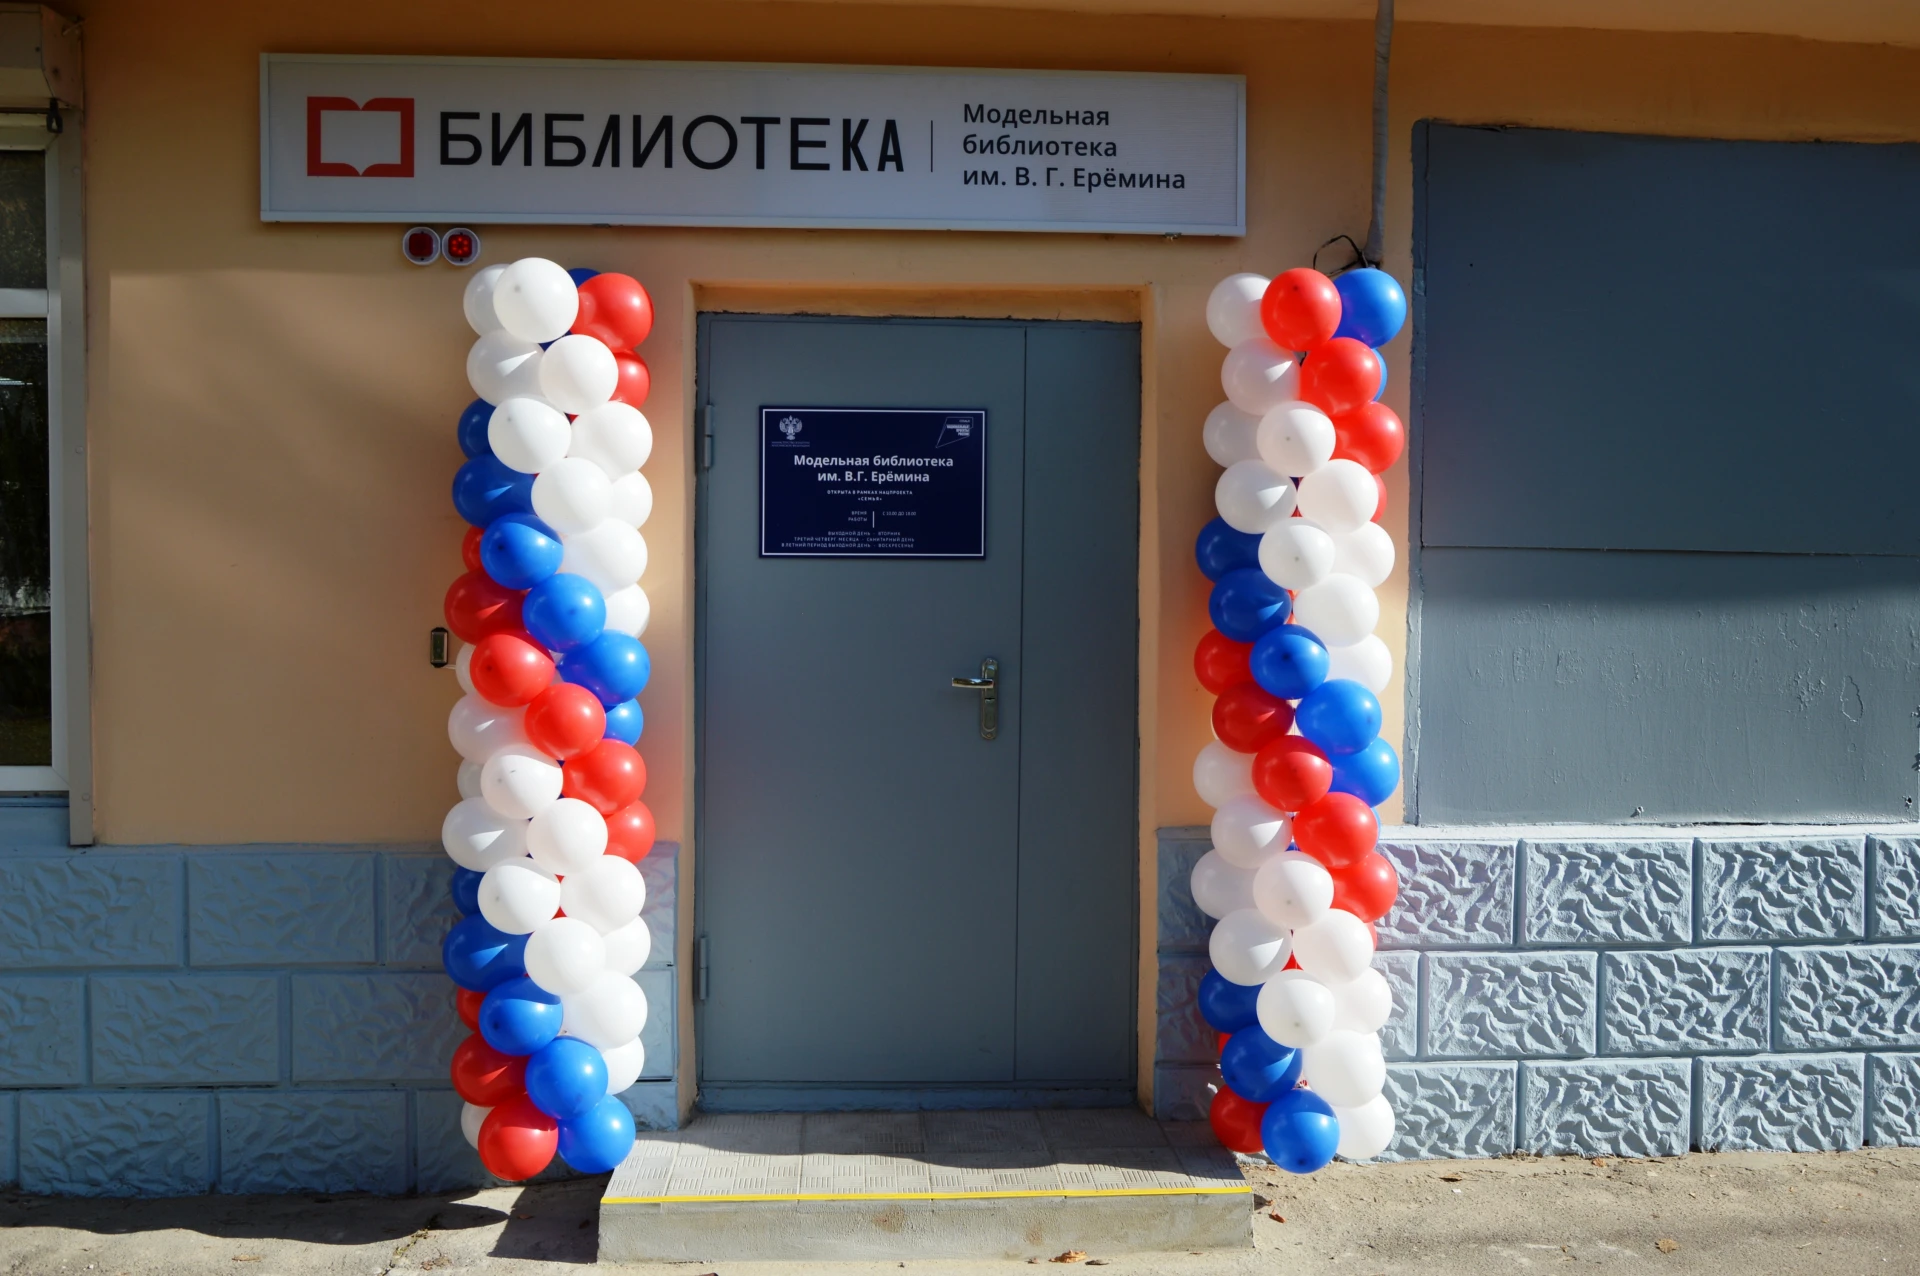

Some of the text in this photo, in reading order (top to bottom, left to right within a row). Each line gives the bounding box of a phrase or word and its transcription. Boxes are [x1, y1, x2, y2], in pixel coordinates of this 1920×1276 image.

[963, 104, 1110, 128] Модельная
[440, 111, 904, 172] БИБЛИОТЕКА
[963, 134, 1117, 157] библиотека
[963, 167, 1186, 193] им. В. Г. Ерёмина
[794, 455, 954, 468] Модельная библиотека
[817, 471, 930, 484] им. В.Г. Ерёмина
